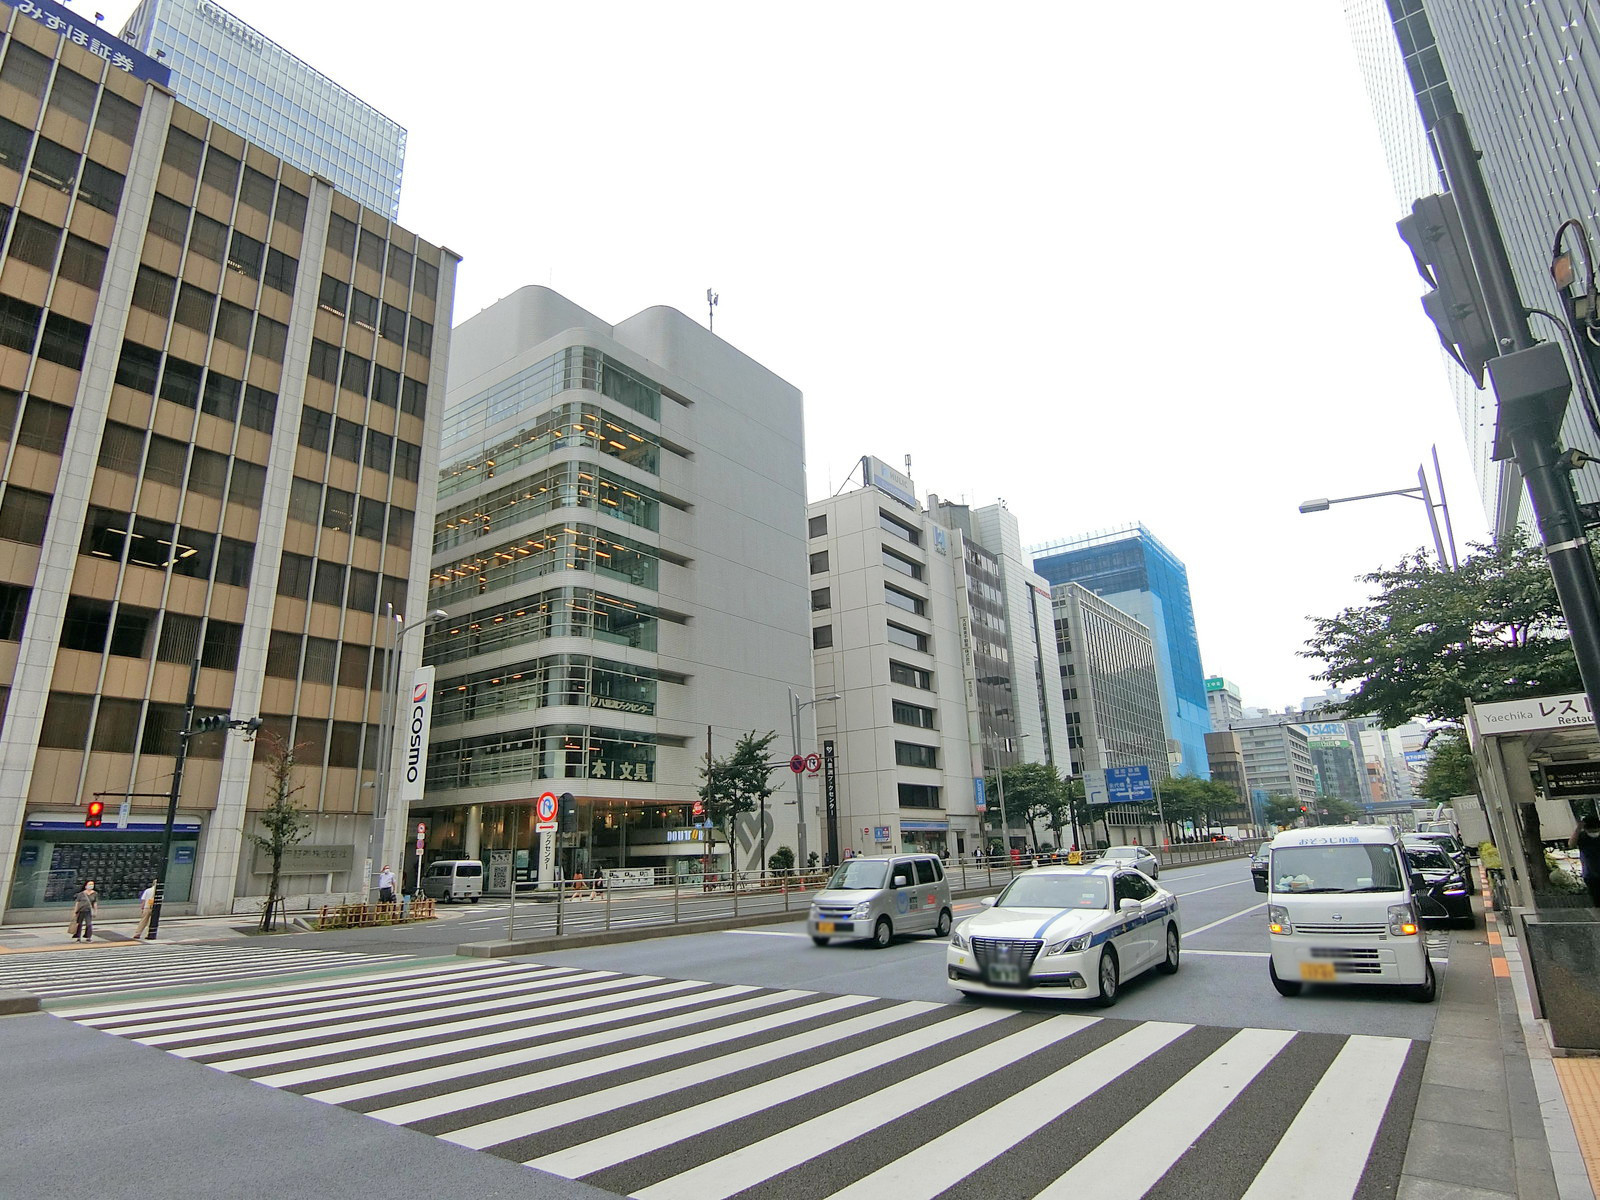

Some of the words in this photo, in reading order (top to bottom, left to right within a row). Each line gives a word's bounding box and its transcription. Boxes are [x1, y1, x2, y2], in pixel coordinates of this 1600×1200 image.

[18, 0, 134, 73] みずほ証券
[1483, 711, 1534, 723] Yaechika
[1311, 723, 1346, 736] STARTS
[591, 759, 607, 778] 本
[619, 761, 648, 781] 文具
[667, 828, 704, 842] DOUTOR
